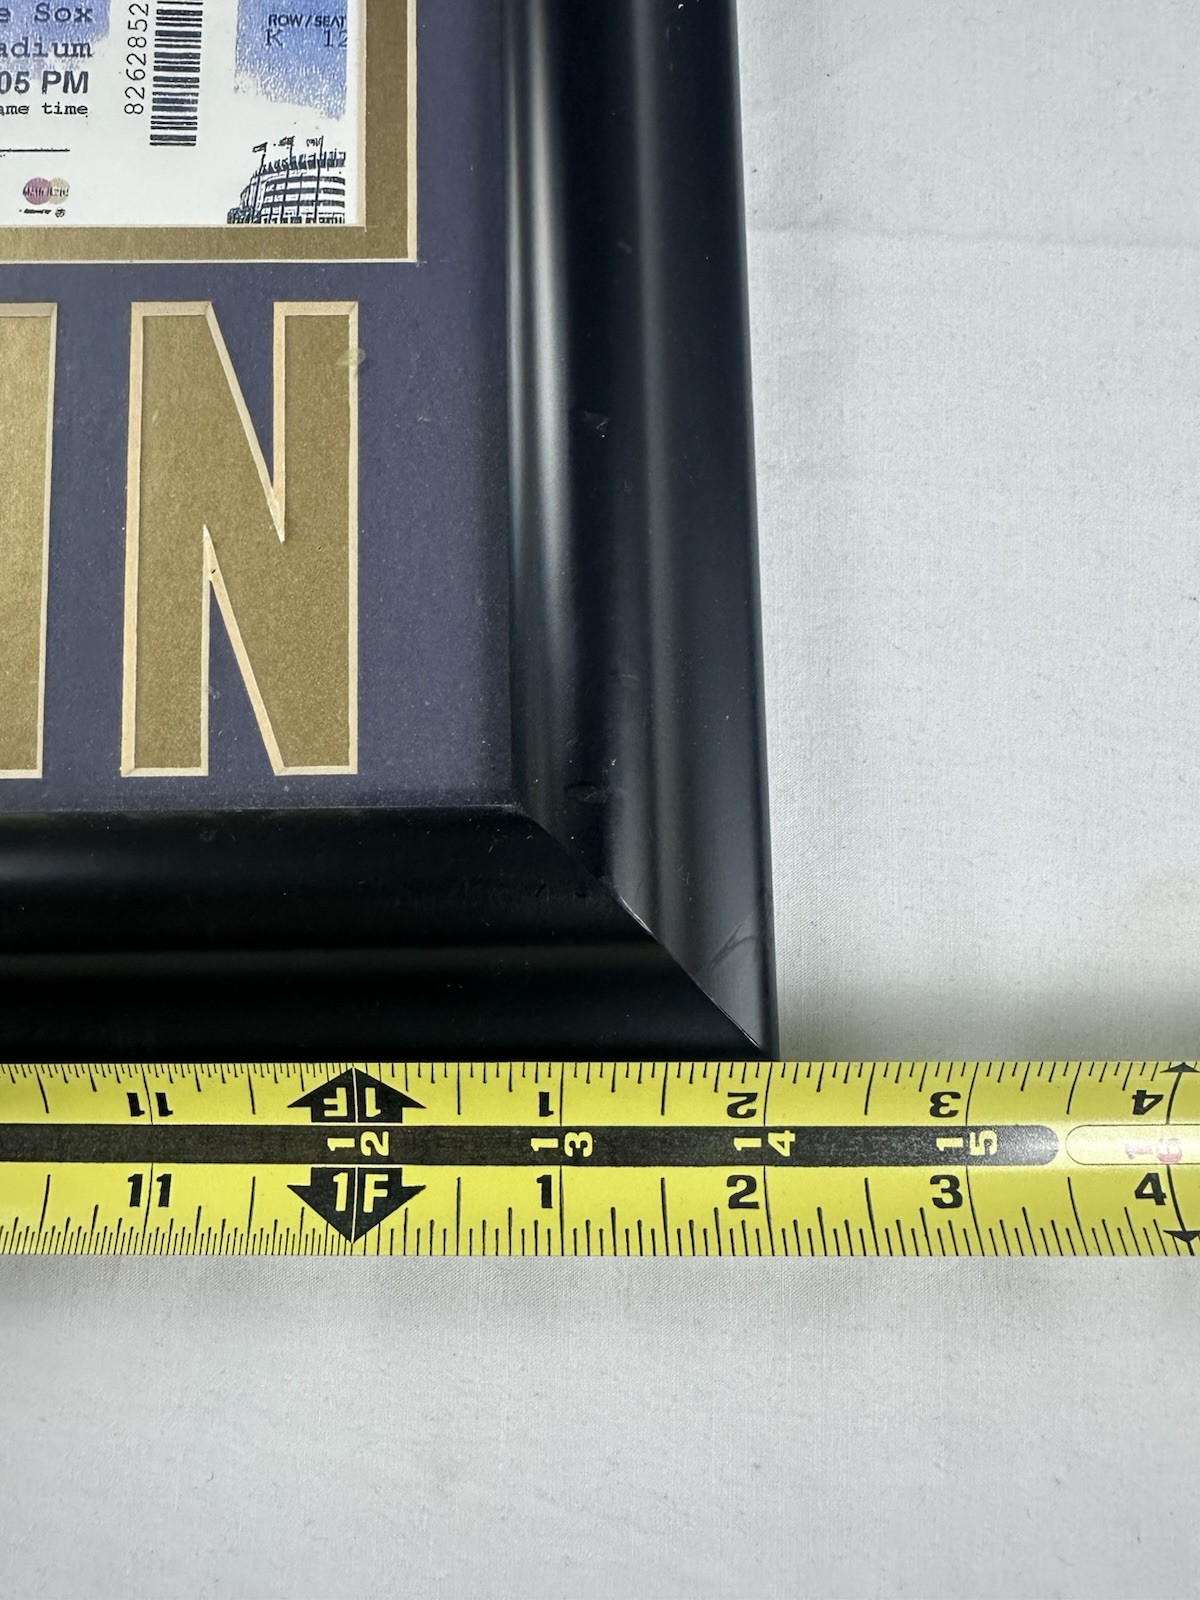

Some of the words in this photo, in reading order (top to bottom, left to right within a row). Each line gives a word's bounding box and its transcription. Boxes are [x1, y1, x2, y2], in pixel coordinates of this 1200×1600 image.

[34, 2, 93, 23] Sox
[268, 14, 346, 28] ROW/SEAT
[265, 29, 283, 47] K
[124, 2, 149, 115] 8262852
[41, 70, 89, 94] PM
[127, 1091, 173, 1117] 11
[538, 1091, 554, 1117] 1
[726, 1092, 758, 1119] 2
[929, 1091, 961, 1117] 3
[1132, 1090, 1164, 1115] 4
[127, 1174, 173, 1207] 11
[536, 1175, 553, 1208] 1
[727, 1175, 760, 1209] 2
[930, 1175, 963, 1209] 3
[1134, 1172, 1167, 1206] 4
